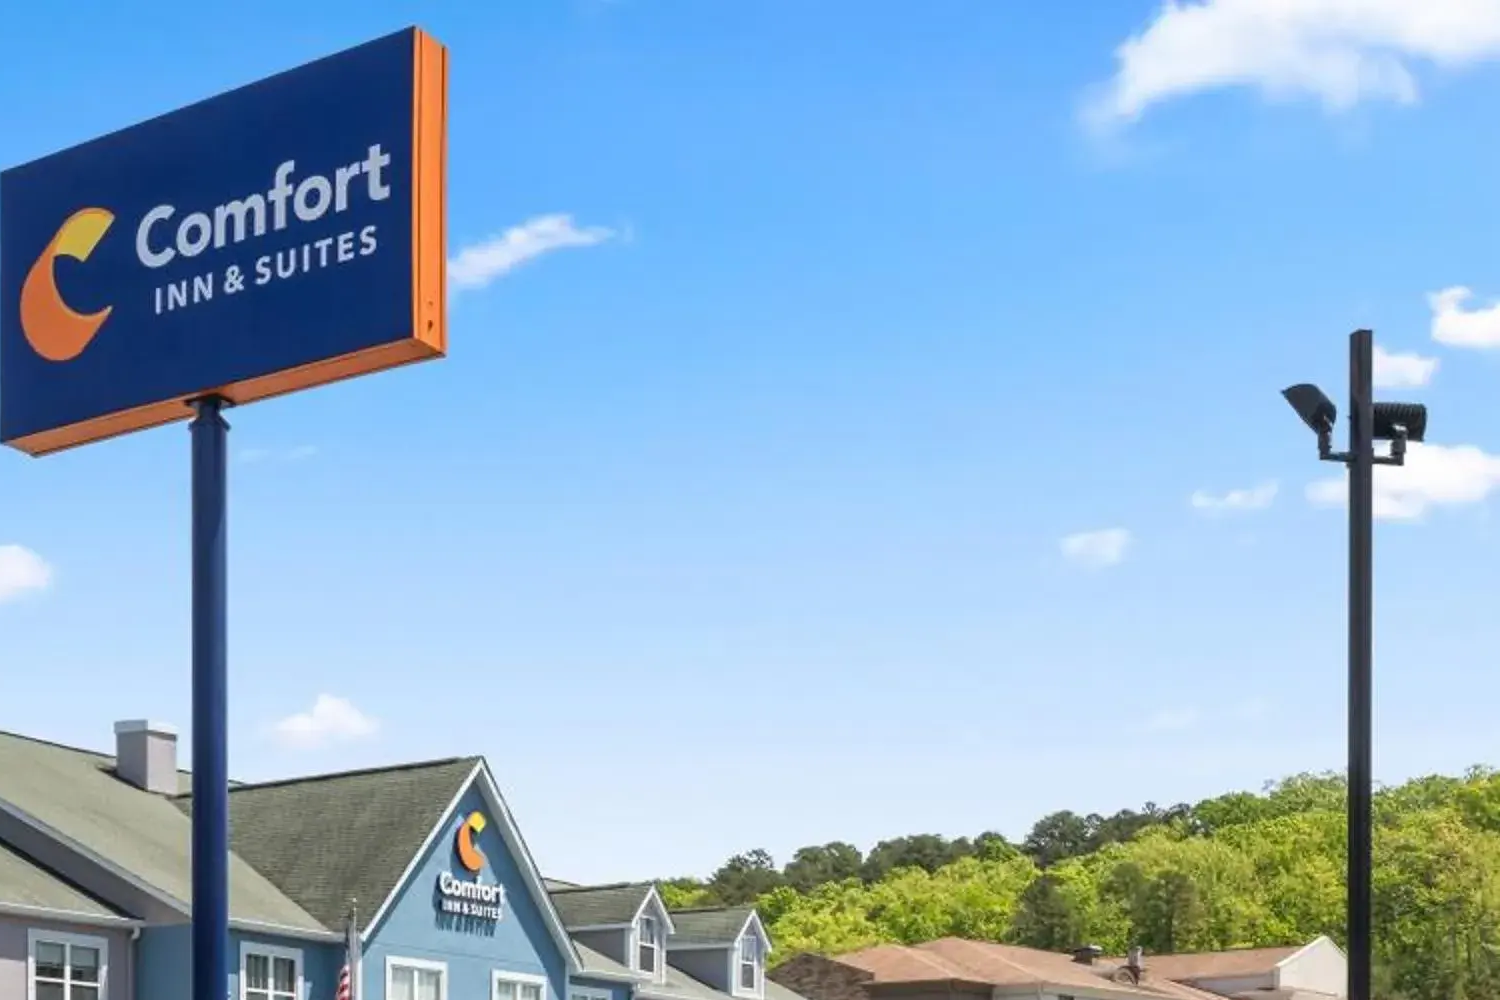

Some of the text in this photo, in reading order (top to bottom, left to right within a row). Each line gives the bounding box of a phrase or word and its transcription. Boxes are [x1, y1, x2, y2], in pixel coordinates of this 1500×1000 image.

[136, 143, 391, 269] Comfort
[154, 225, 378, 315] INN & SUITES
[439, 871, 504, 905] Comfort
[442, 898, 461, 913] INN
[470, 903, 502, 920] SUITES
